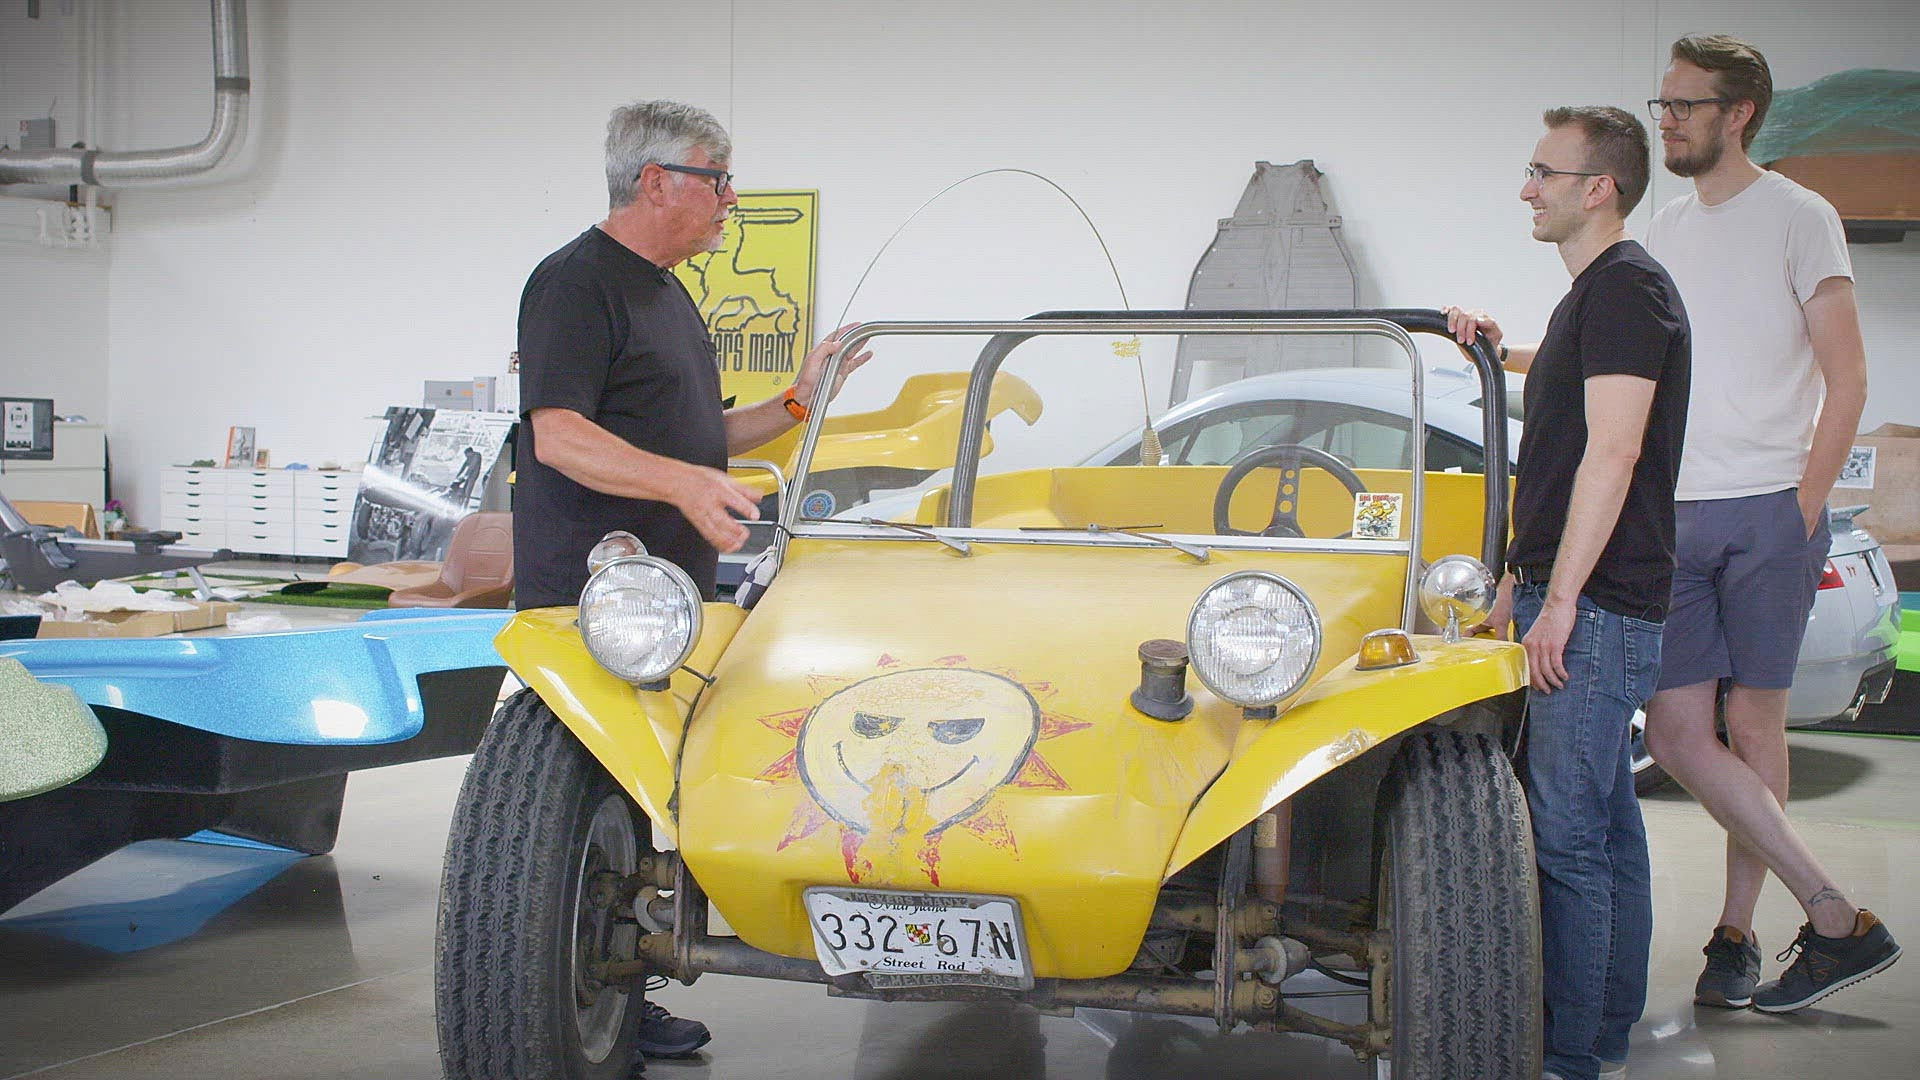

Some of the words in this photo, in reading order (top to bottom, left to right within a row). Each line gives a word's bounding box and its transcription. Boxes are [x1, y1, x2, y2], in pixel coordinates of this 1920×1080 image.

[709, 332, 744, 371] ers
[882, 956, 924, 969] Street
[937, 960, 966, 971] Rod
[889, 974, 953, 987] MEYERS
